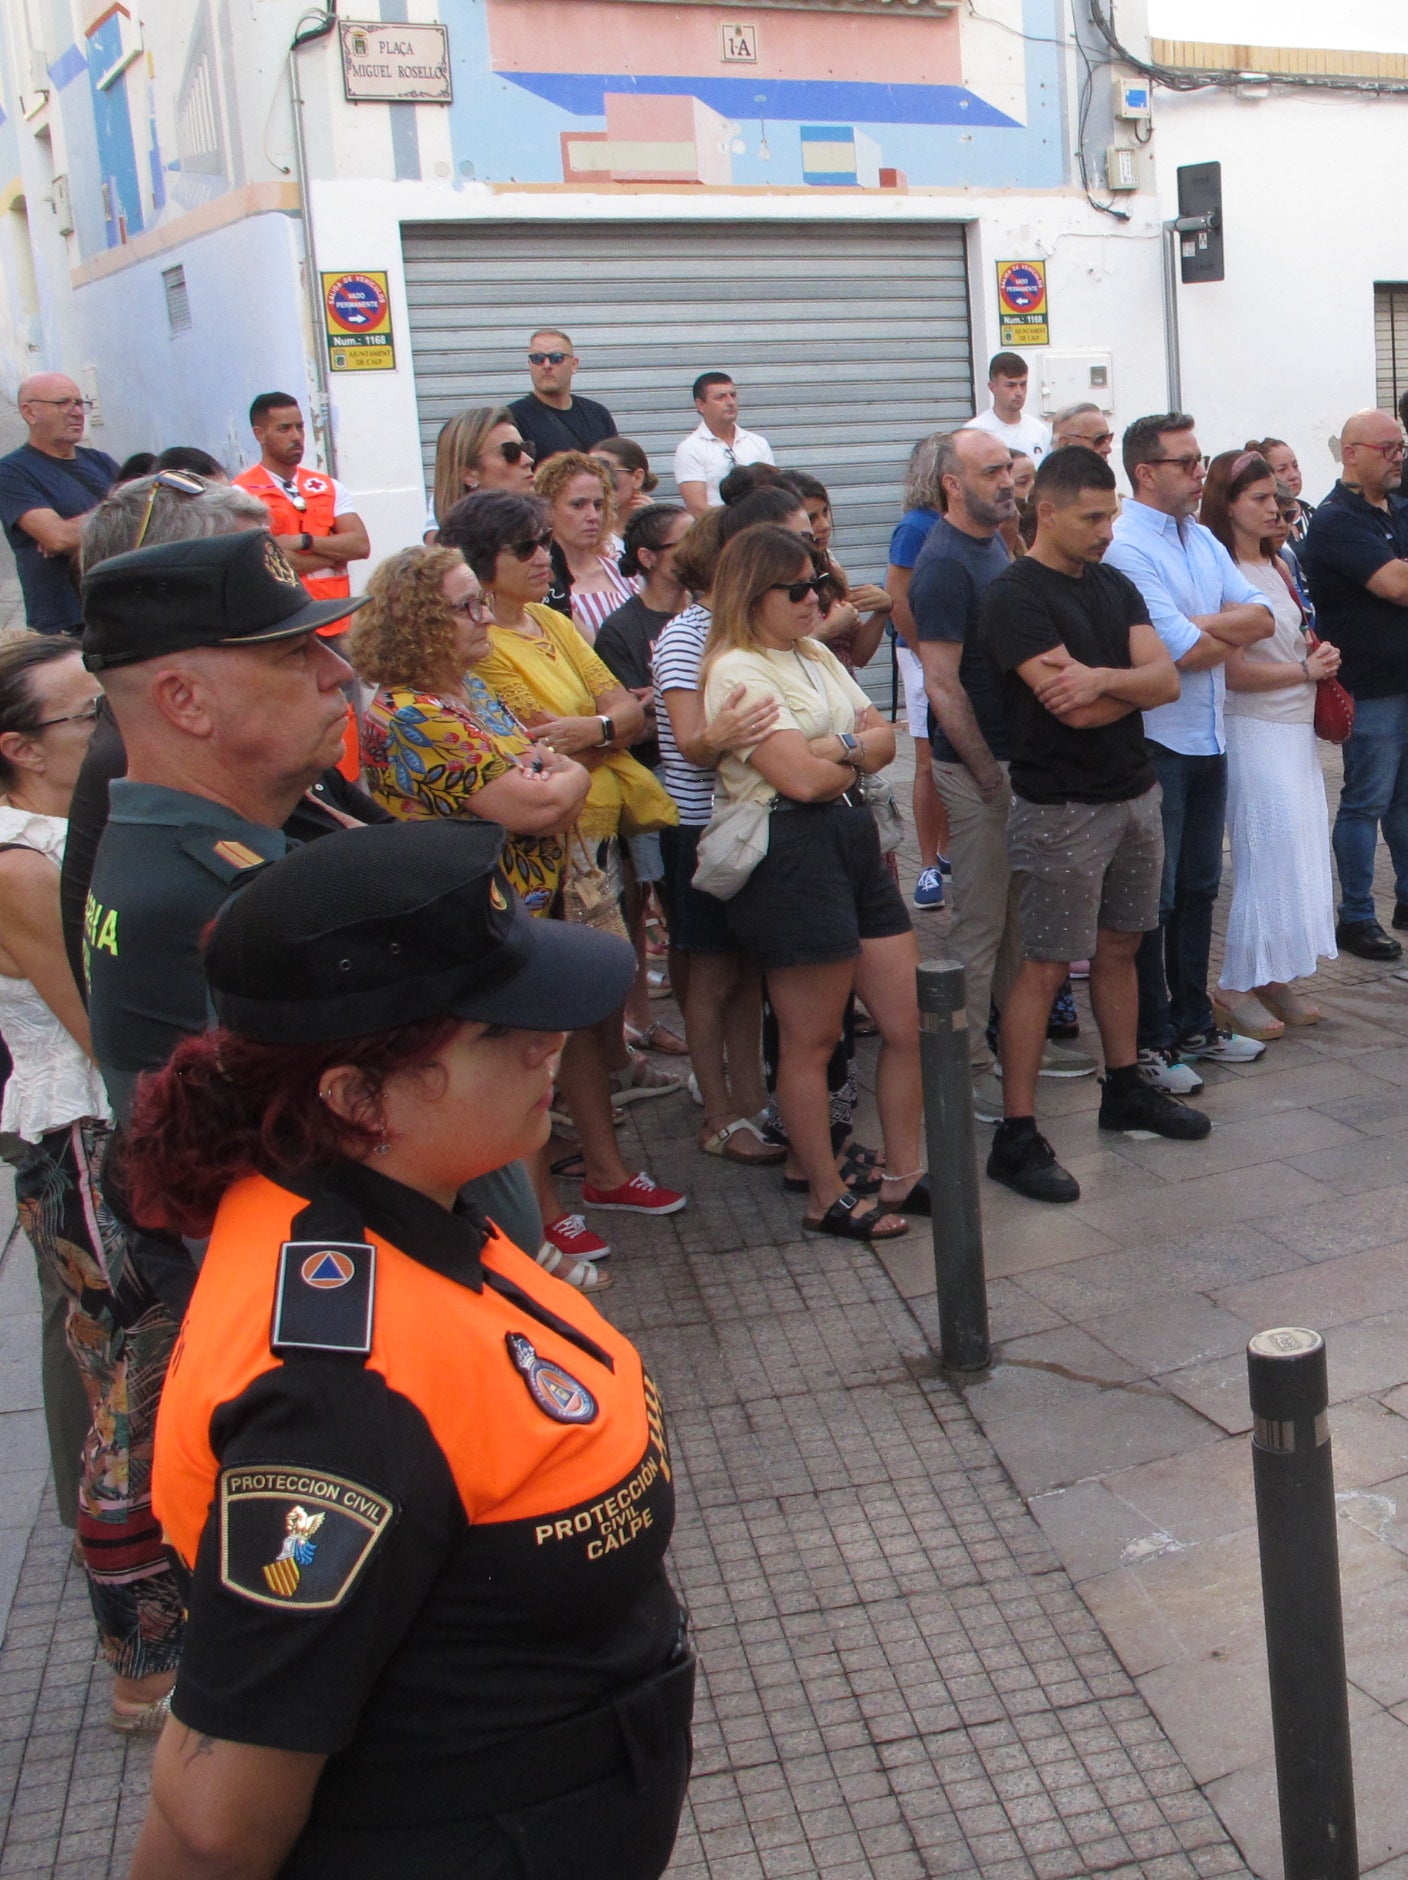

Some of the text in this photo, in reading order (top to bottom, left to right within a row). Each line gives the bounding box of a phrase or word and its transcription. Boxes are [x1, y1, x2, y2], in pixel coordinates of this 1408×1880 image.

[378, 40, 414, 57] PLAÇA
[352, 64, 393, 78] MIGUEL
[328, 282, 343, 305] SALIDA
[348, 292, 366, 300] VADO
[335, 301, 379, 309] PERMANENTE
[365, 335, 387, 345] 1168
[230, 1474, 384, 1522] PROTECCION CIVIL
[535, 1456, 659, 1546] PROTECCIÓN
[600, 1505, 639, 1536] CIVIL
[587, 1508, 654, 1560] CALPE
